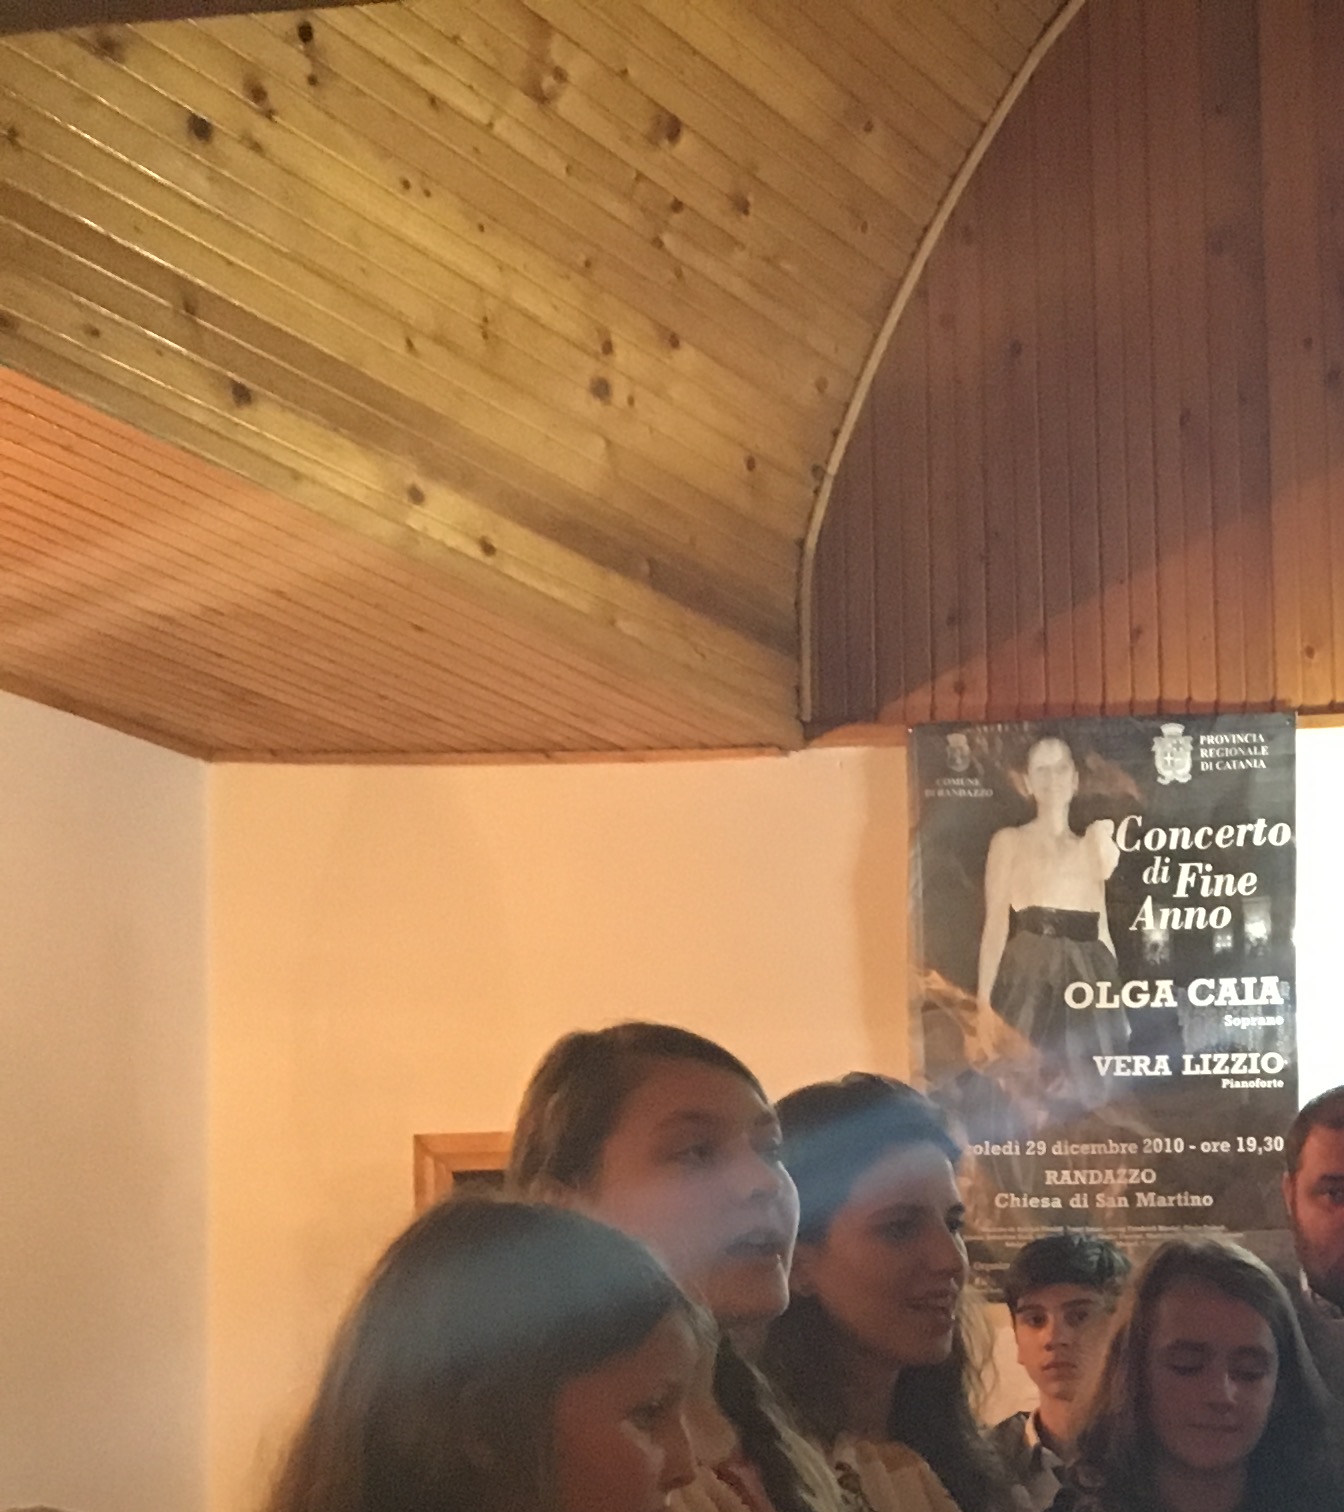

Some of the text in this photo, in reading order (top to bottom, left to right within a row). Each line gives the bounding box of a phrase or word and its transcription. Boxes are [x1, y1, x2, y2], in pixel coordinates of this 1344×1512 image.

[1199, 732, 1265, 745] PROVINCIA
[1199, 745, 1270, 758] REGIONALE
[1199, 758, 1267, 771] DI CATANIA
[935, 777, 981, 787] COMUNE
[936, 788, 994, 798] RANDAZZO
[1117, 814, 1293, 852] Concerto
[1142, 856, 1259, 898] di Fine
[1129, 896, 1233, 932] Anno
[1064, 976, 1285, 1010] OLGA CAIA
[1092, 1053, 1285, 1077] VERA LIZZIO
[1221, 1078, 1285, 1090] Pianoforte
[1025, 1140, 1047, 1157] 29
[1051, 1138, 1139, 1156] dicembre
[1142, 1137, 1185, 1155] 2010
[1200, 1141, 1231, 1154] ore
[1236, 1136, 1285, 1157] 19,30
[1044, 1168, 1158, 1186] RANDAZZO
[994, 1191, 1215, 1210] Chiesa di San Martino
